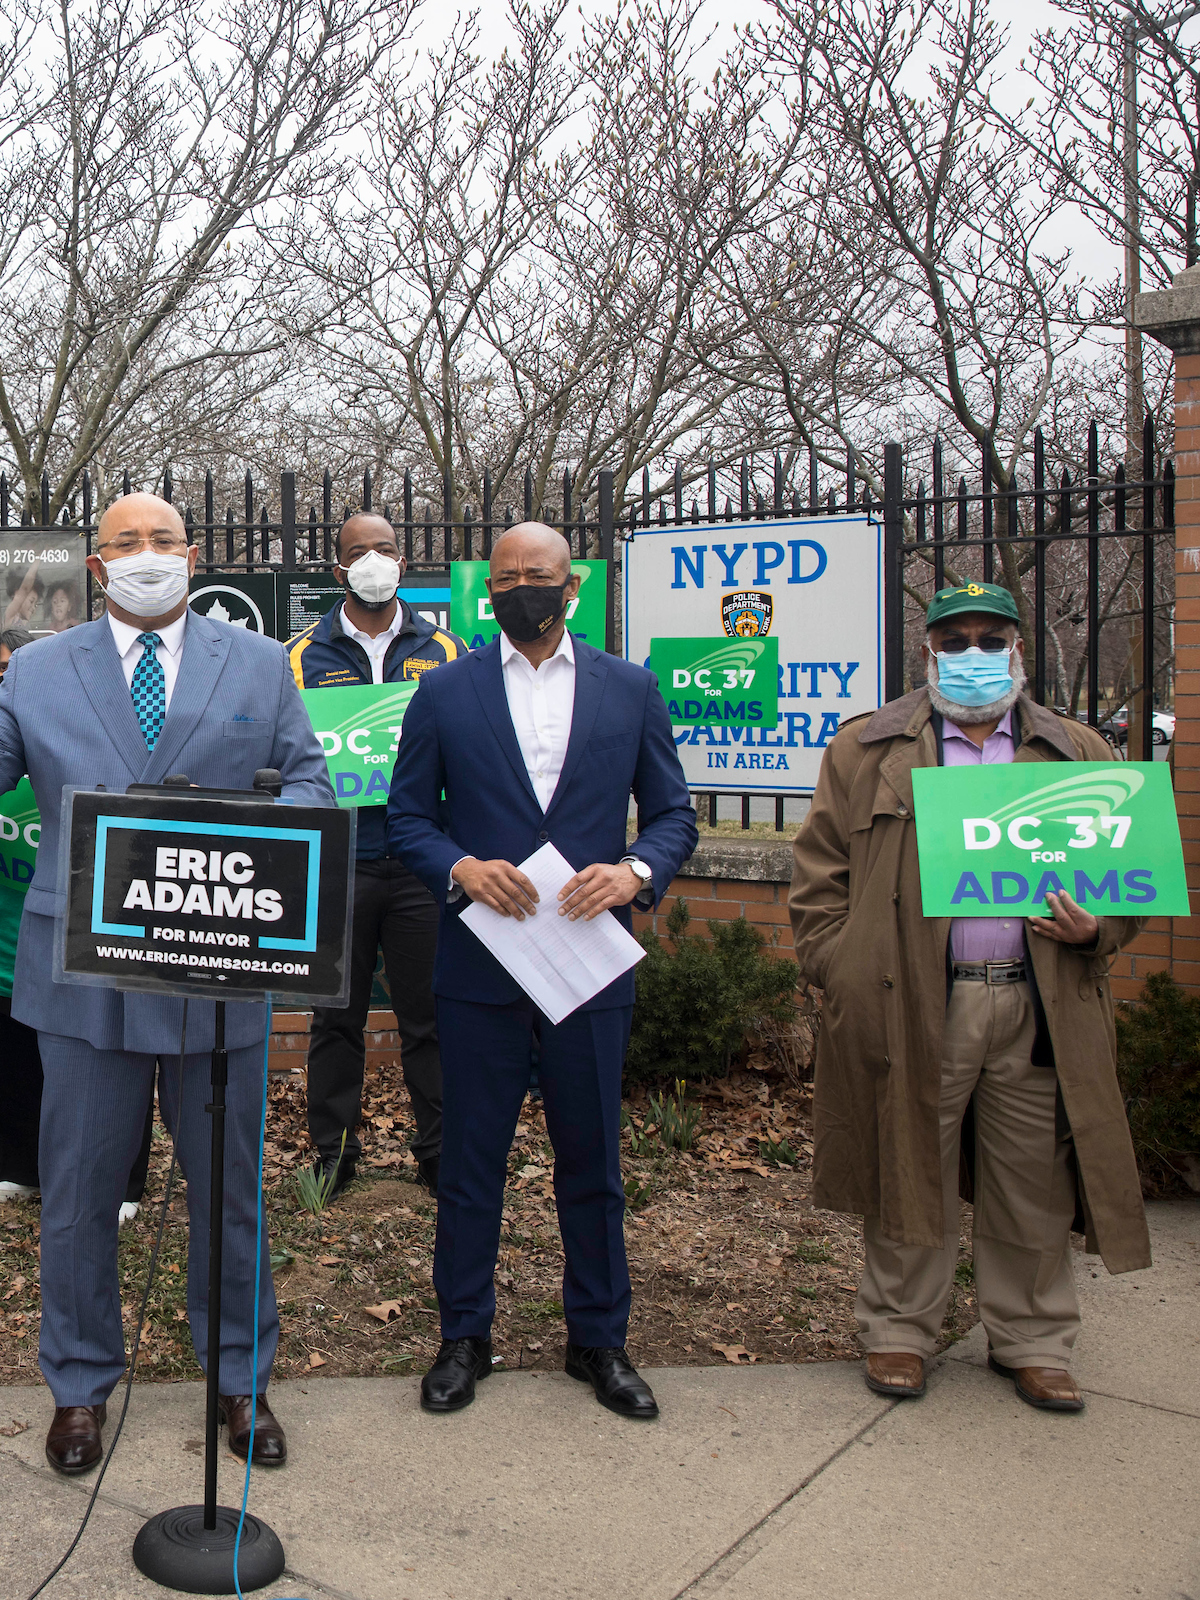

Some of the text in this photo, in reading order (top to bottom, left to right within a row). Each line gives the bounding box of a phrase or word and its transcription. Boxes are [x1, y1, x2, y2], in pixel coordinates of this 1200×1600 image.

[13, 549, 69, 563] 276-4630
[670, 538, 828, 589] NYPD
[732, 593, 761, 602] POLICE
[723, 601, 772, 615] DEPARTMENT
[724, 619, 735, 637] CITY
[760, 616, 771, 634] YORK
[672, 669, 756, 689] DC 37
[704, 689, 722, 697] FOR
[667, 700, 763, 720] ADAMS
[315, 728, 372, 757] DC
[363, 754, 389, 764] FOR
[707, 752, 790, 770] IN AREA
[962, 816, 1132, 850] DC 37
[154, 846, 256, 885] ERIC
[1031, 851, 1067, 863] FOR
[950, 869, 1157, 905] ADAMS
[122, 879, 284, 922] ADAMS
[152, 927, 251, 949] FOR MAYOR
[96, 945, 310, 976] WWW.ERICADAMS2021.COM
